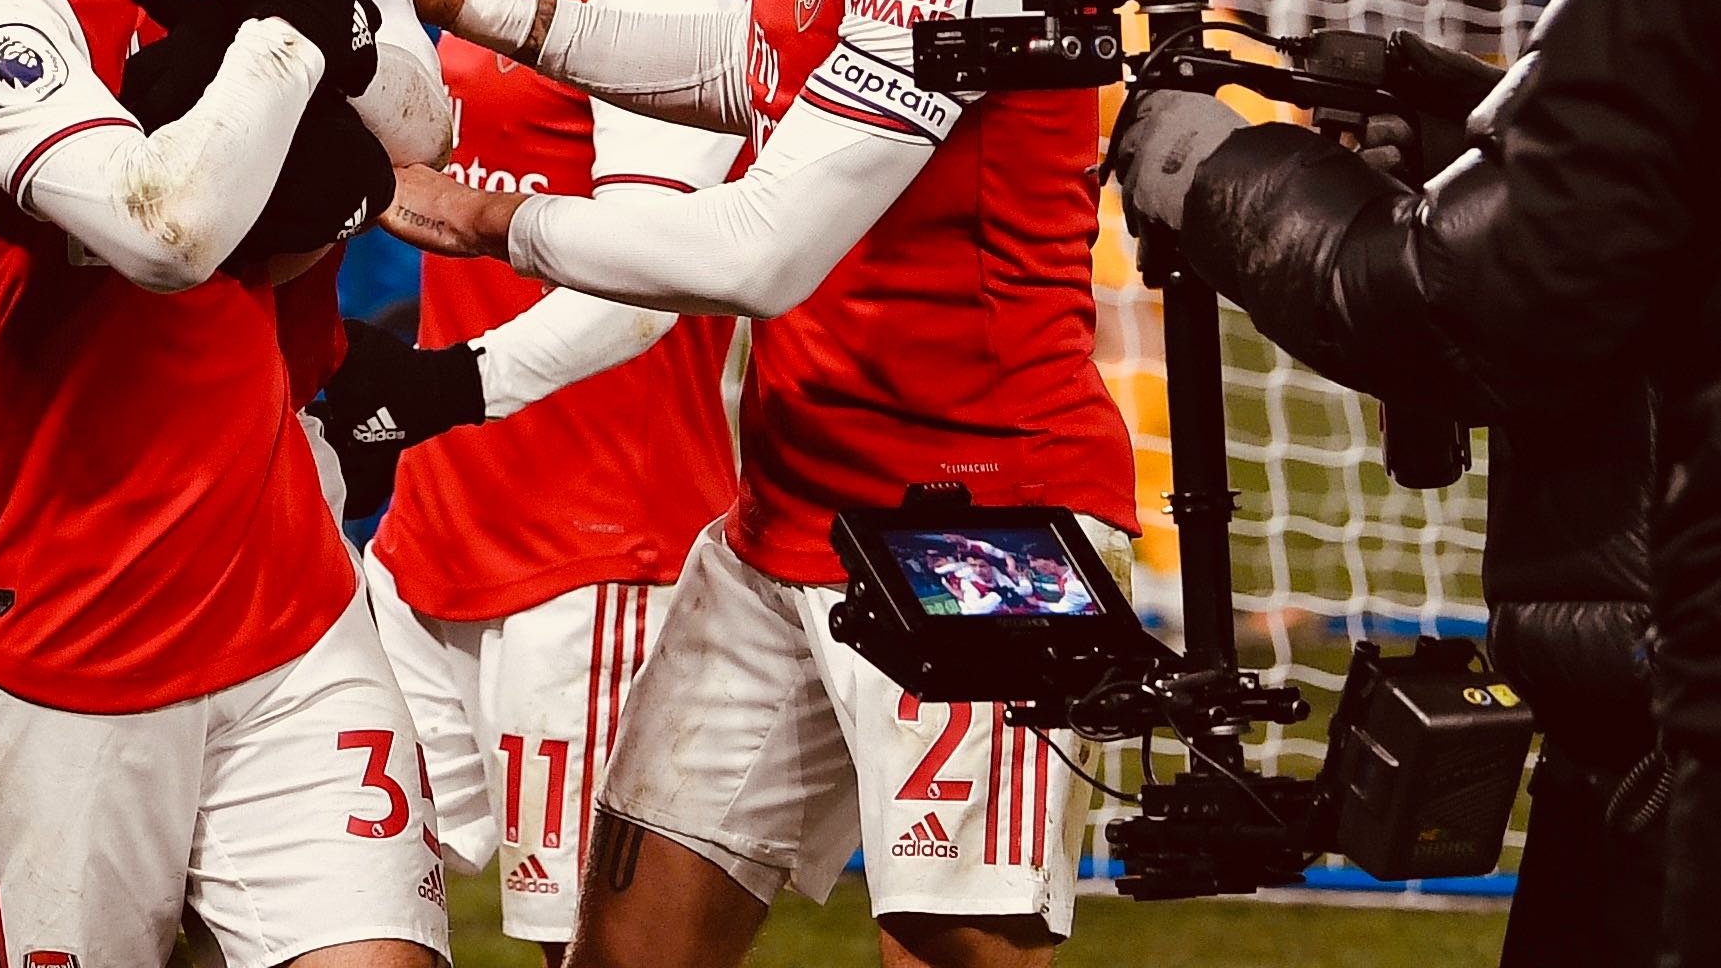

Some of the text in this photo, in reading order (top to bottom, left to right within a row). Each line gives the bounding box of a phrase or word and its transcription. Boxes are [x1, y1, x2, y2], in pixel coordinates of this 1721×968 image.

[830, 53, 947, 127] Captain
[894, 688, 974, 802] 2
[498, 734, 569, 849] 11
[507, 878, 559, 894] adidas
[891, 839, 959, 860] adidas
